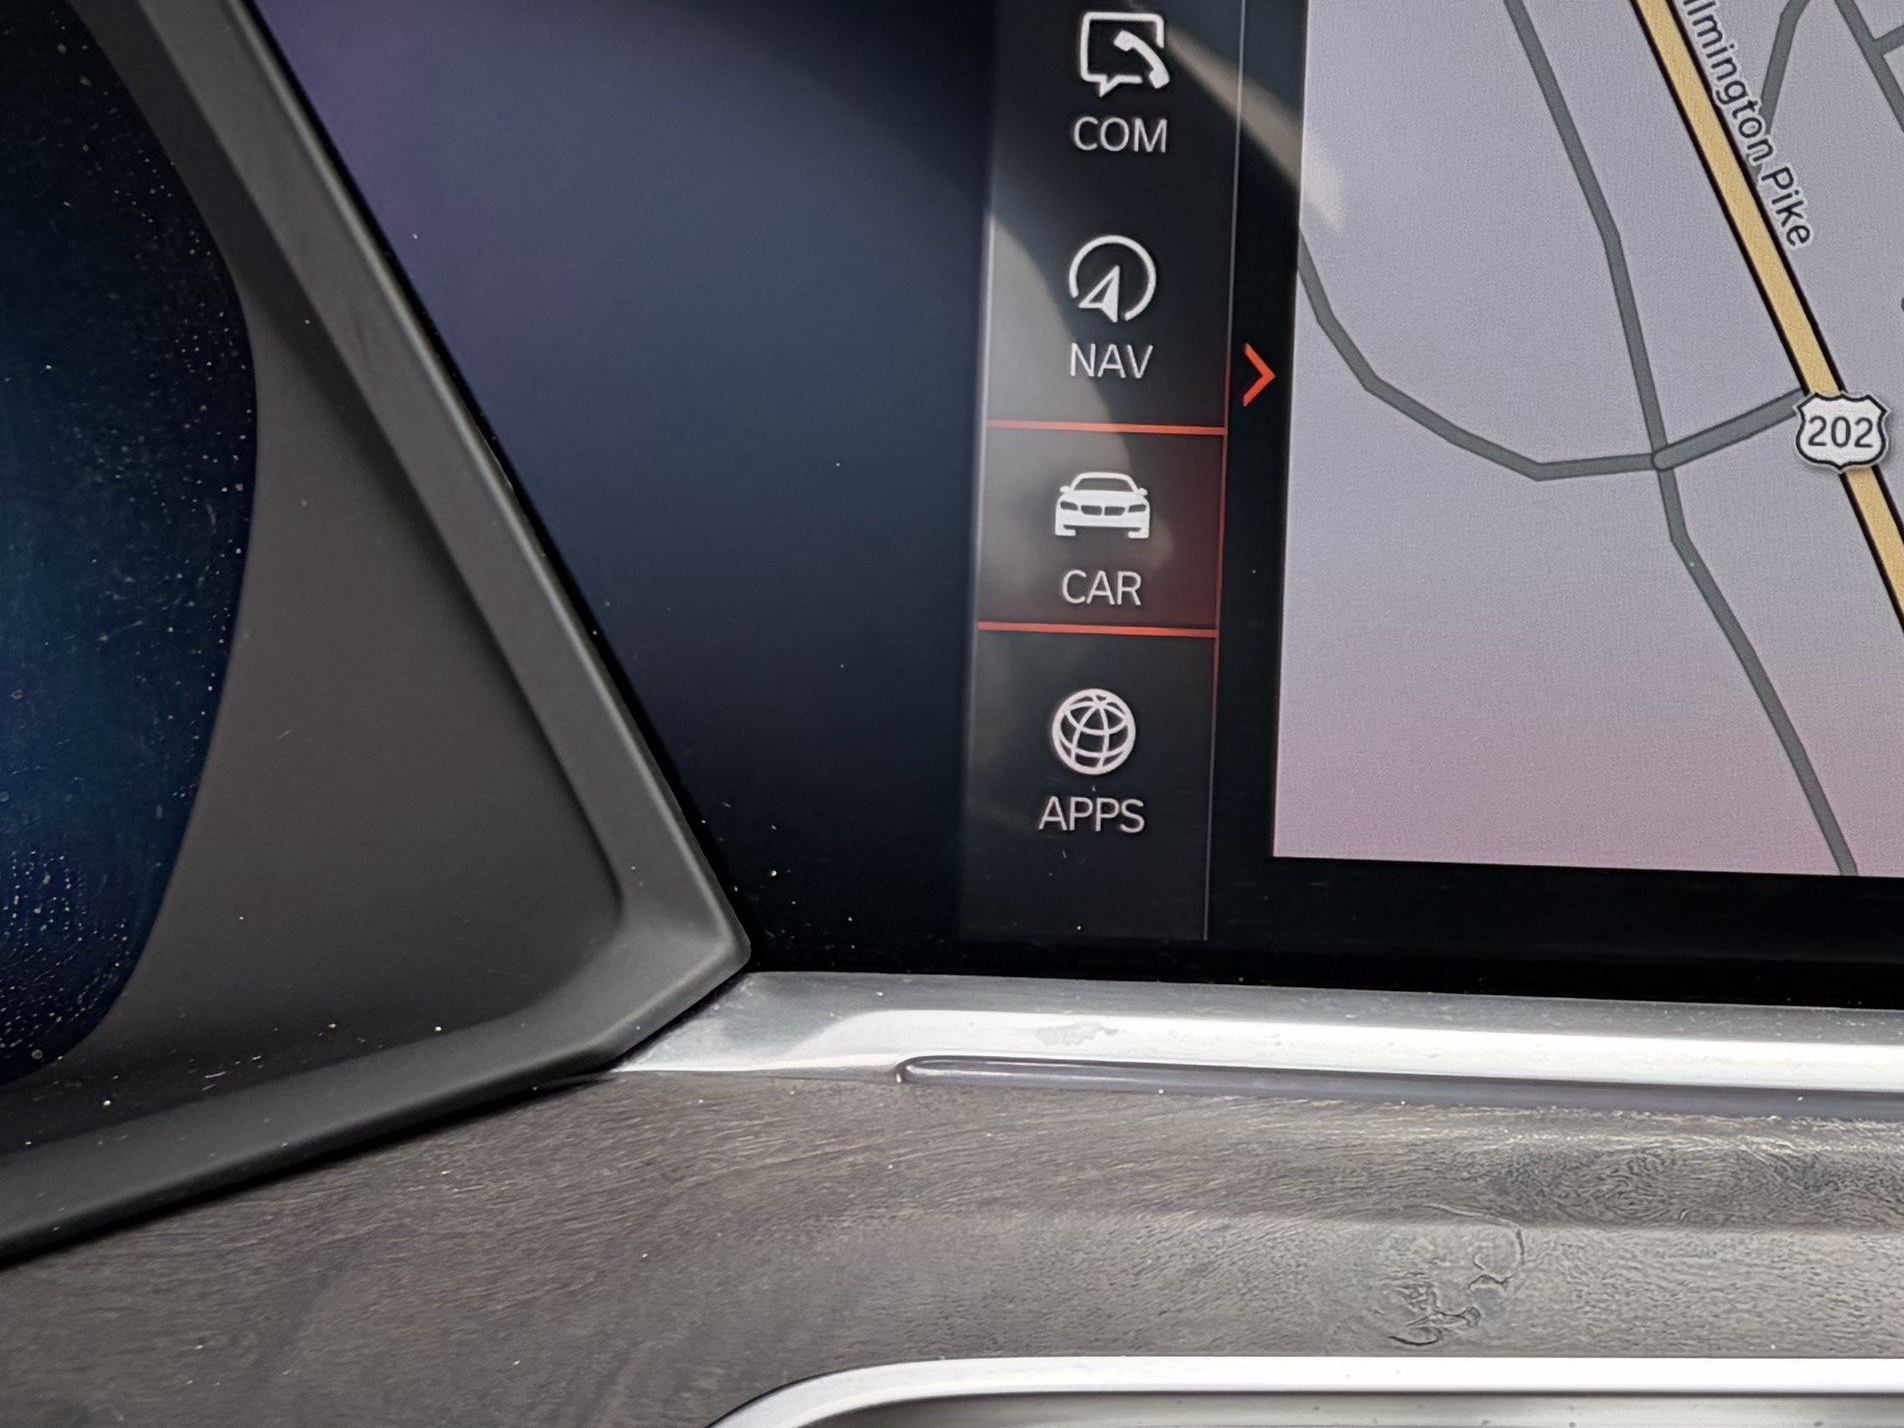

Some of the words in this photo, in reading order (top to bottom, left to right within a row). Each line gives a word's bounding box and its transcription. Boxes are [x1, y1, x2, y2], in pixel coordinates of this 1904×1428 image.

[1072, 117, 1169, 155] COM
[1759, 165, 1815, 247] Pike
[1069, 342, 1154, 380] NAV
[1807, 415, 1873, 449] 202
[1060, 568, 1142, 606] CAR
[1037, 796, 1145, 834] APPS
